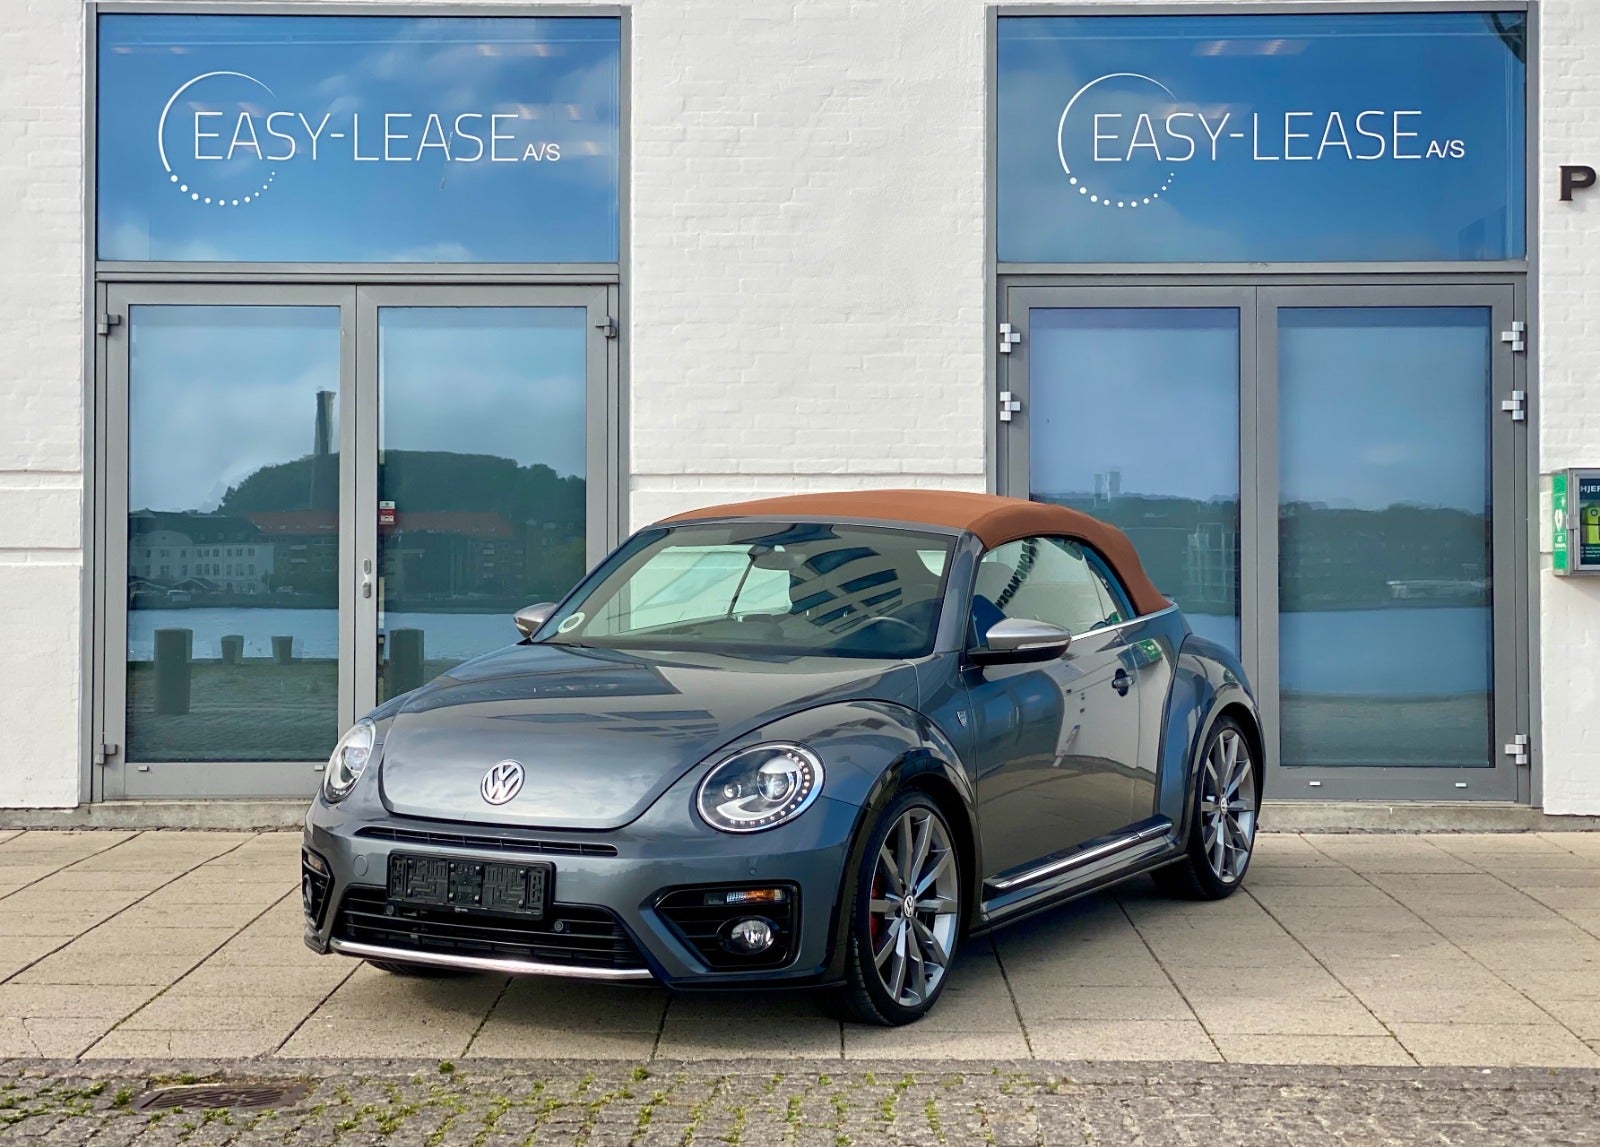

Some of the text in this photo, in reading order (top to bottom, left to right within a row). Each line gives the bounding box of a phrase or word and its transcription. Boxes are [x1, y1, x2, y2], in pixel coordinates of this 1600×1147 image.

[193, 111, 561, 162] EASY-LEASE A/S
[1092, 110, 1465, 161] EASY-LEASE A/S
[1559, 165, 1597, 201] P
